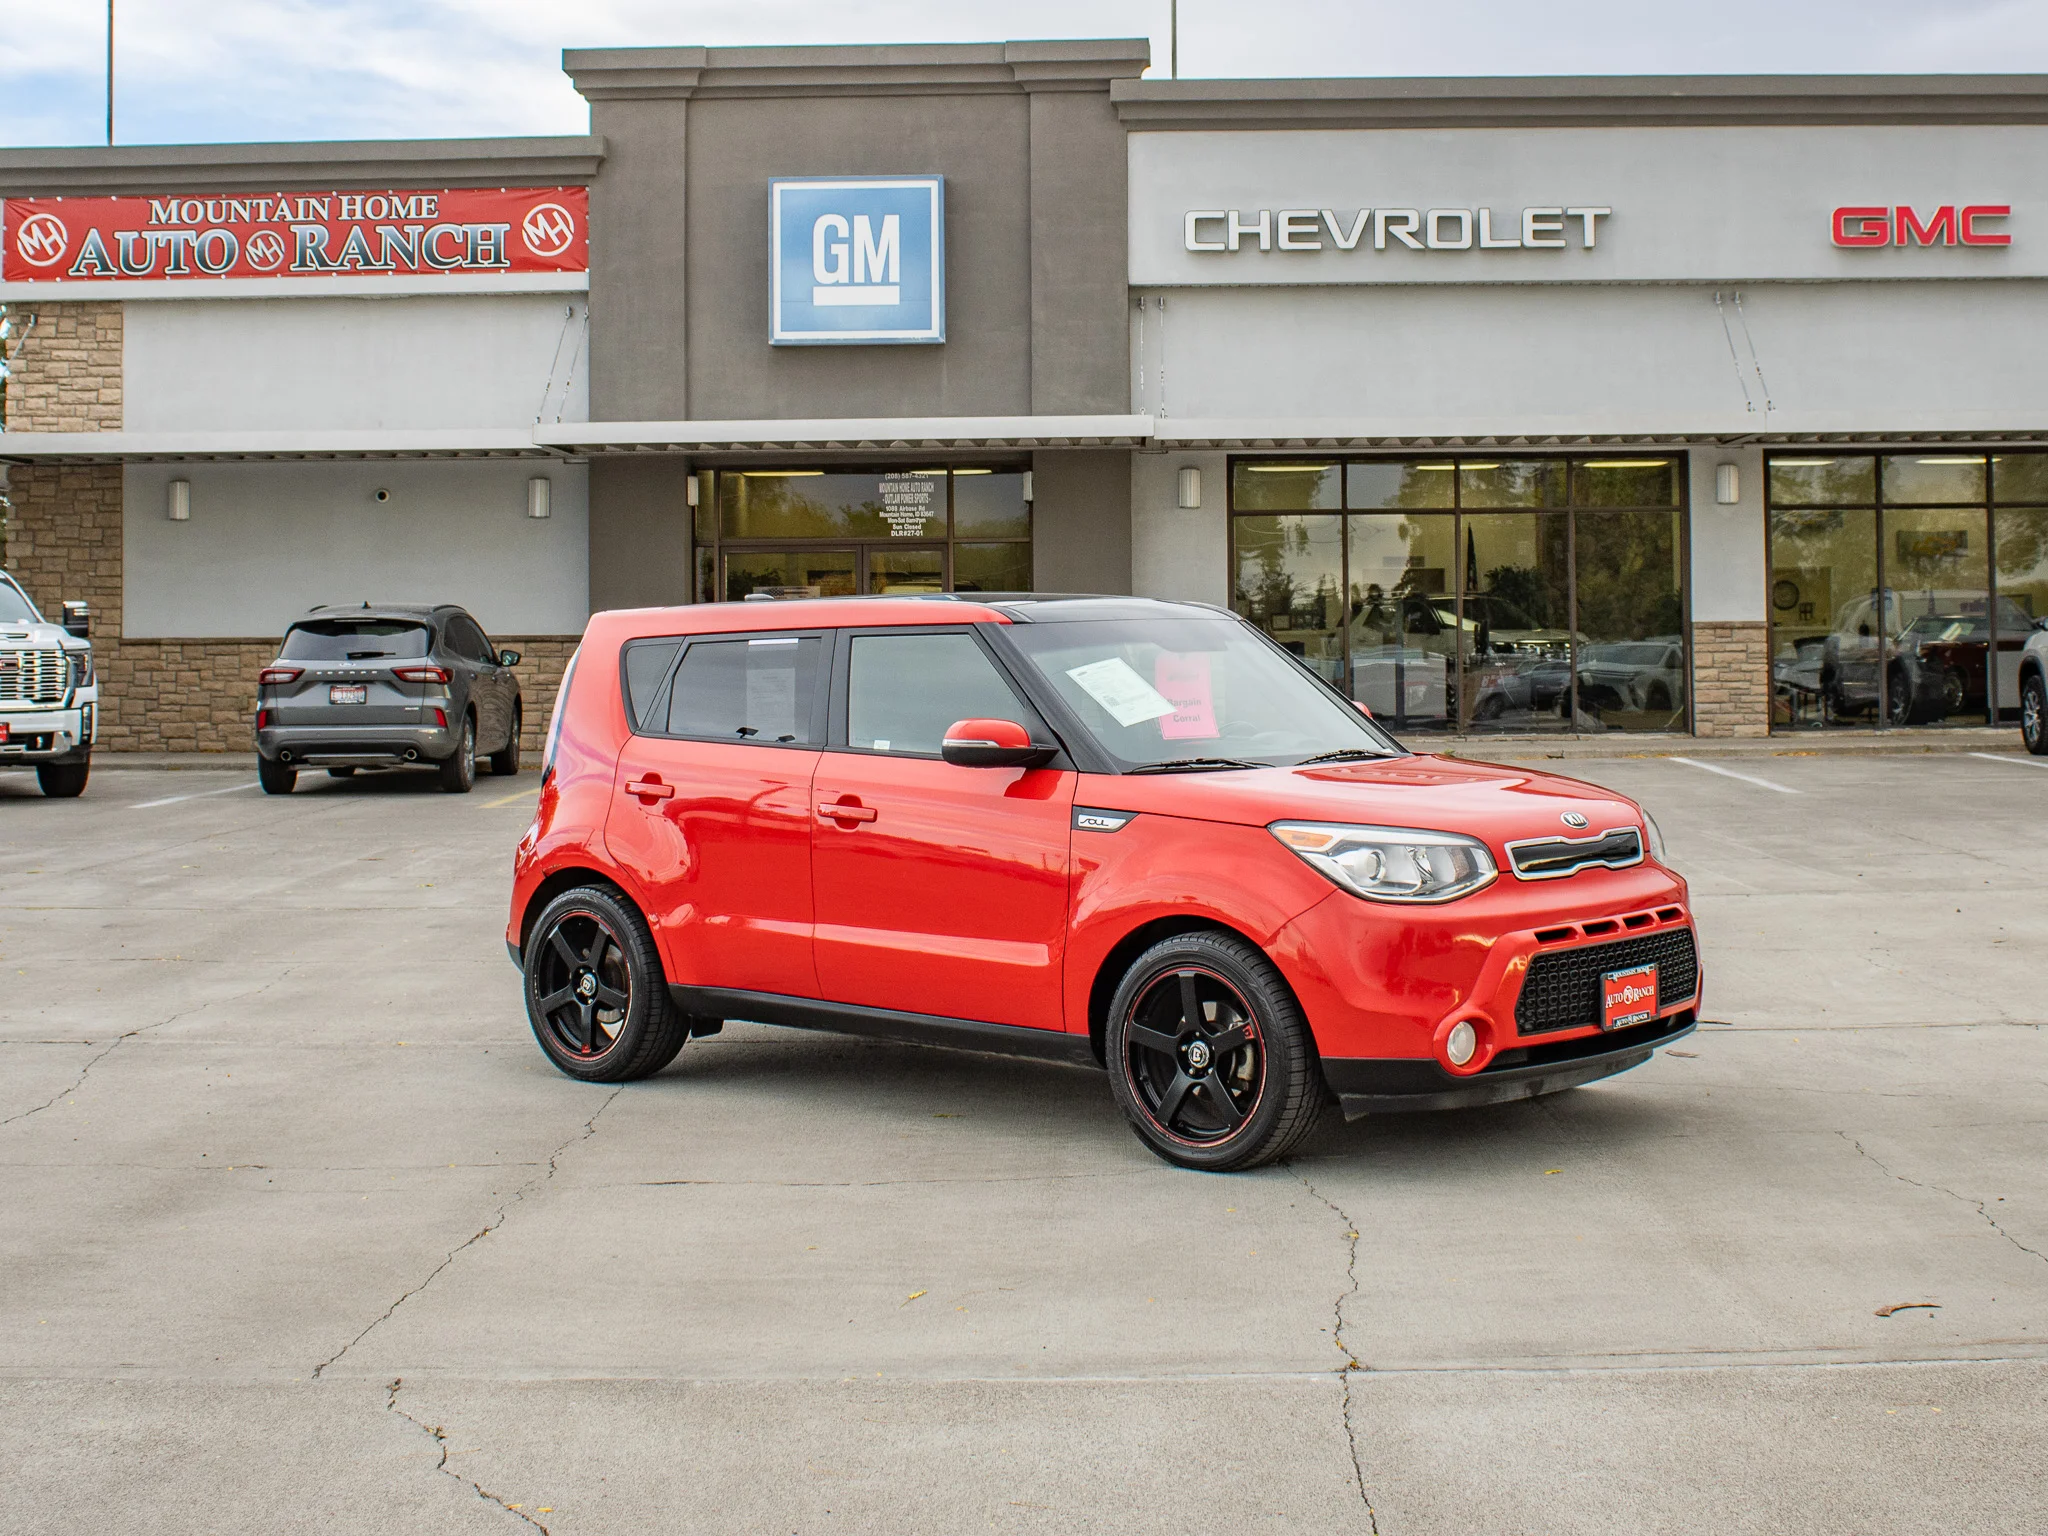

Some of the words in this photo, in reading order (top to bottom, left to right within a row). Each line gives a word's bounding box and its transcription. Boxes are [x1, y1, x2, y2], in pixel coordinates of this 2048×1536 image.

[147, 199, 330, 225] MOUNTAIN
[337, 194, 440, 221] HOME
[1184, 206, 1612, 251] CHEVROLET
[1831, 205, 2012, 247] GMC
[67, 226, 240, 277] AUTO
[288, 222, 511, 272] RANCH
[812, 213, 900, 285] GM
[1173, 714, 1201, 723] Corral
[1605, 992, 1624, 1009] AUTO
[1632, 985, 1655, 1002] RANCH
